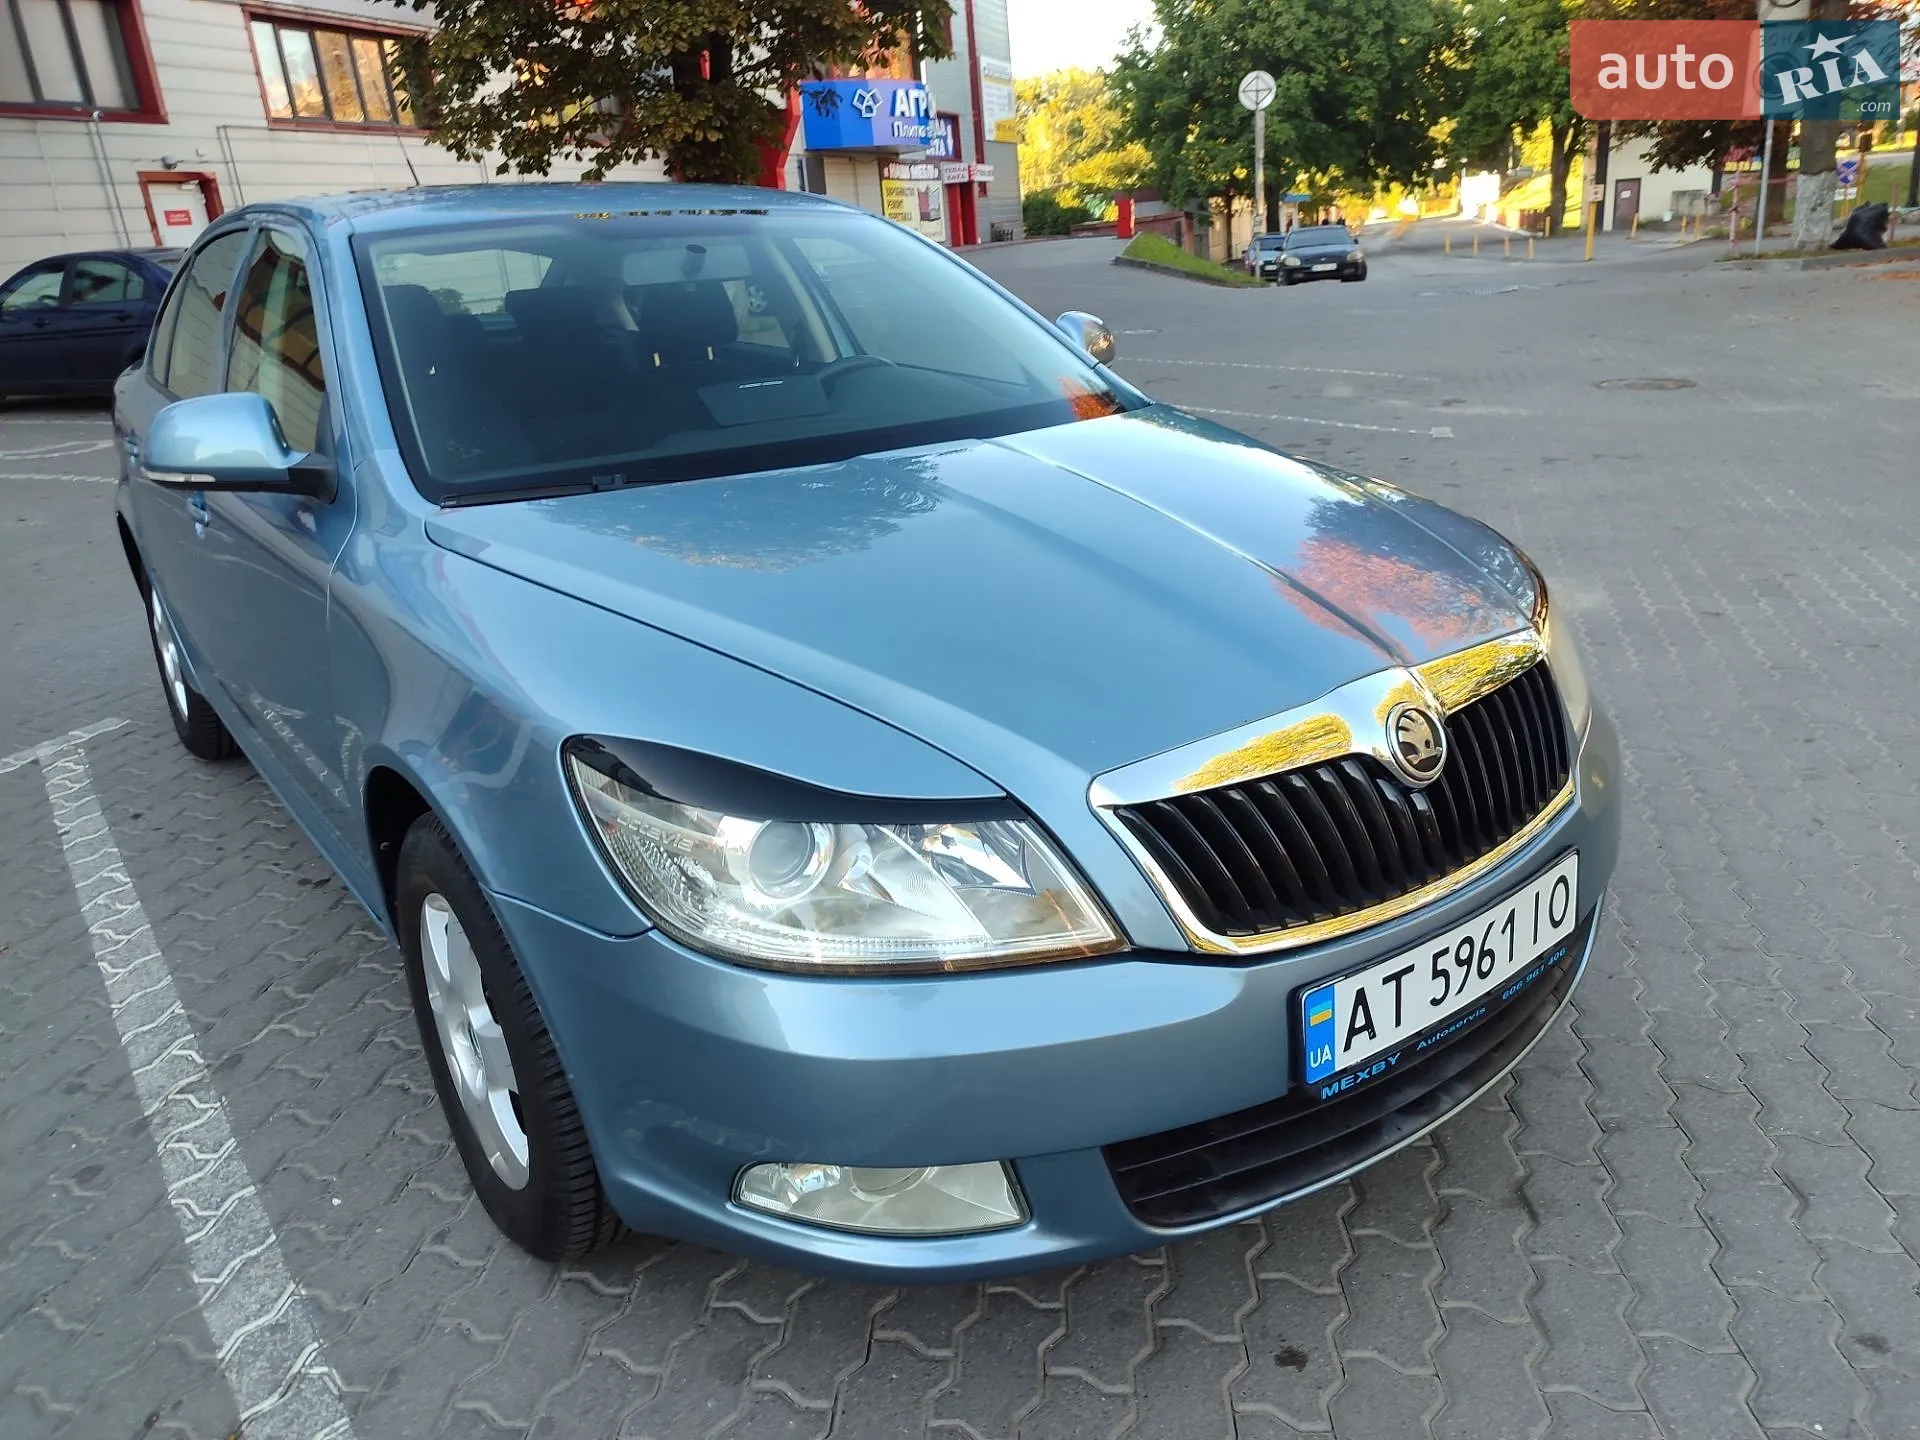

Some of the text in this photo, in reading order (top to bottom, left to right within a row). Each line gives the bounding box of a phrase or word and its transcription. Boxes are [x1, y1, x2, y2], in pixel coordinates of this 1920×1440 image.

[1342, 873, 1571, 1053] AT 5961 IO
[1310, 1043, 1333, 1069] UA
[1321, 1051, 1402, 1100] MEXBY
[1415, 1006, 1487, 1052] Autoservis
